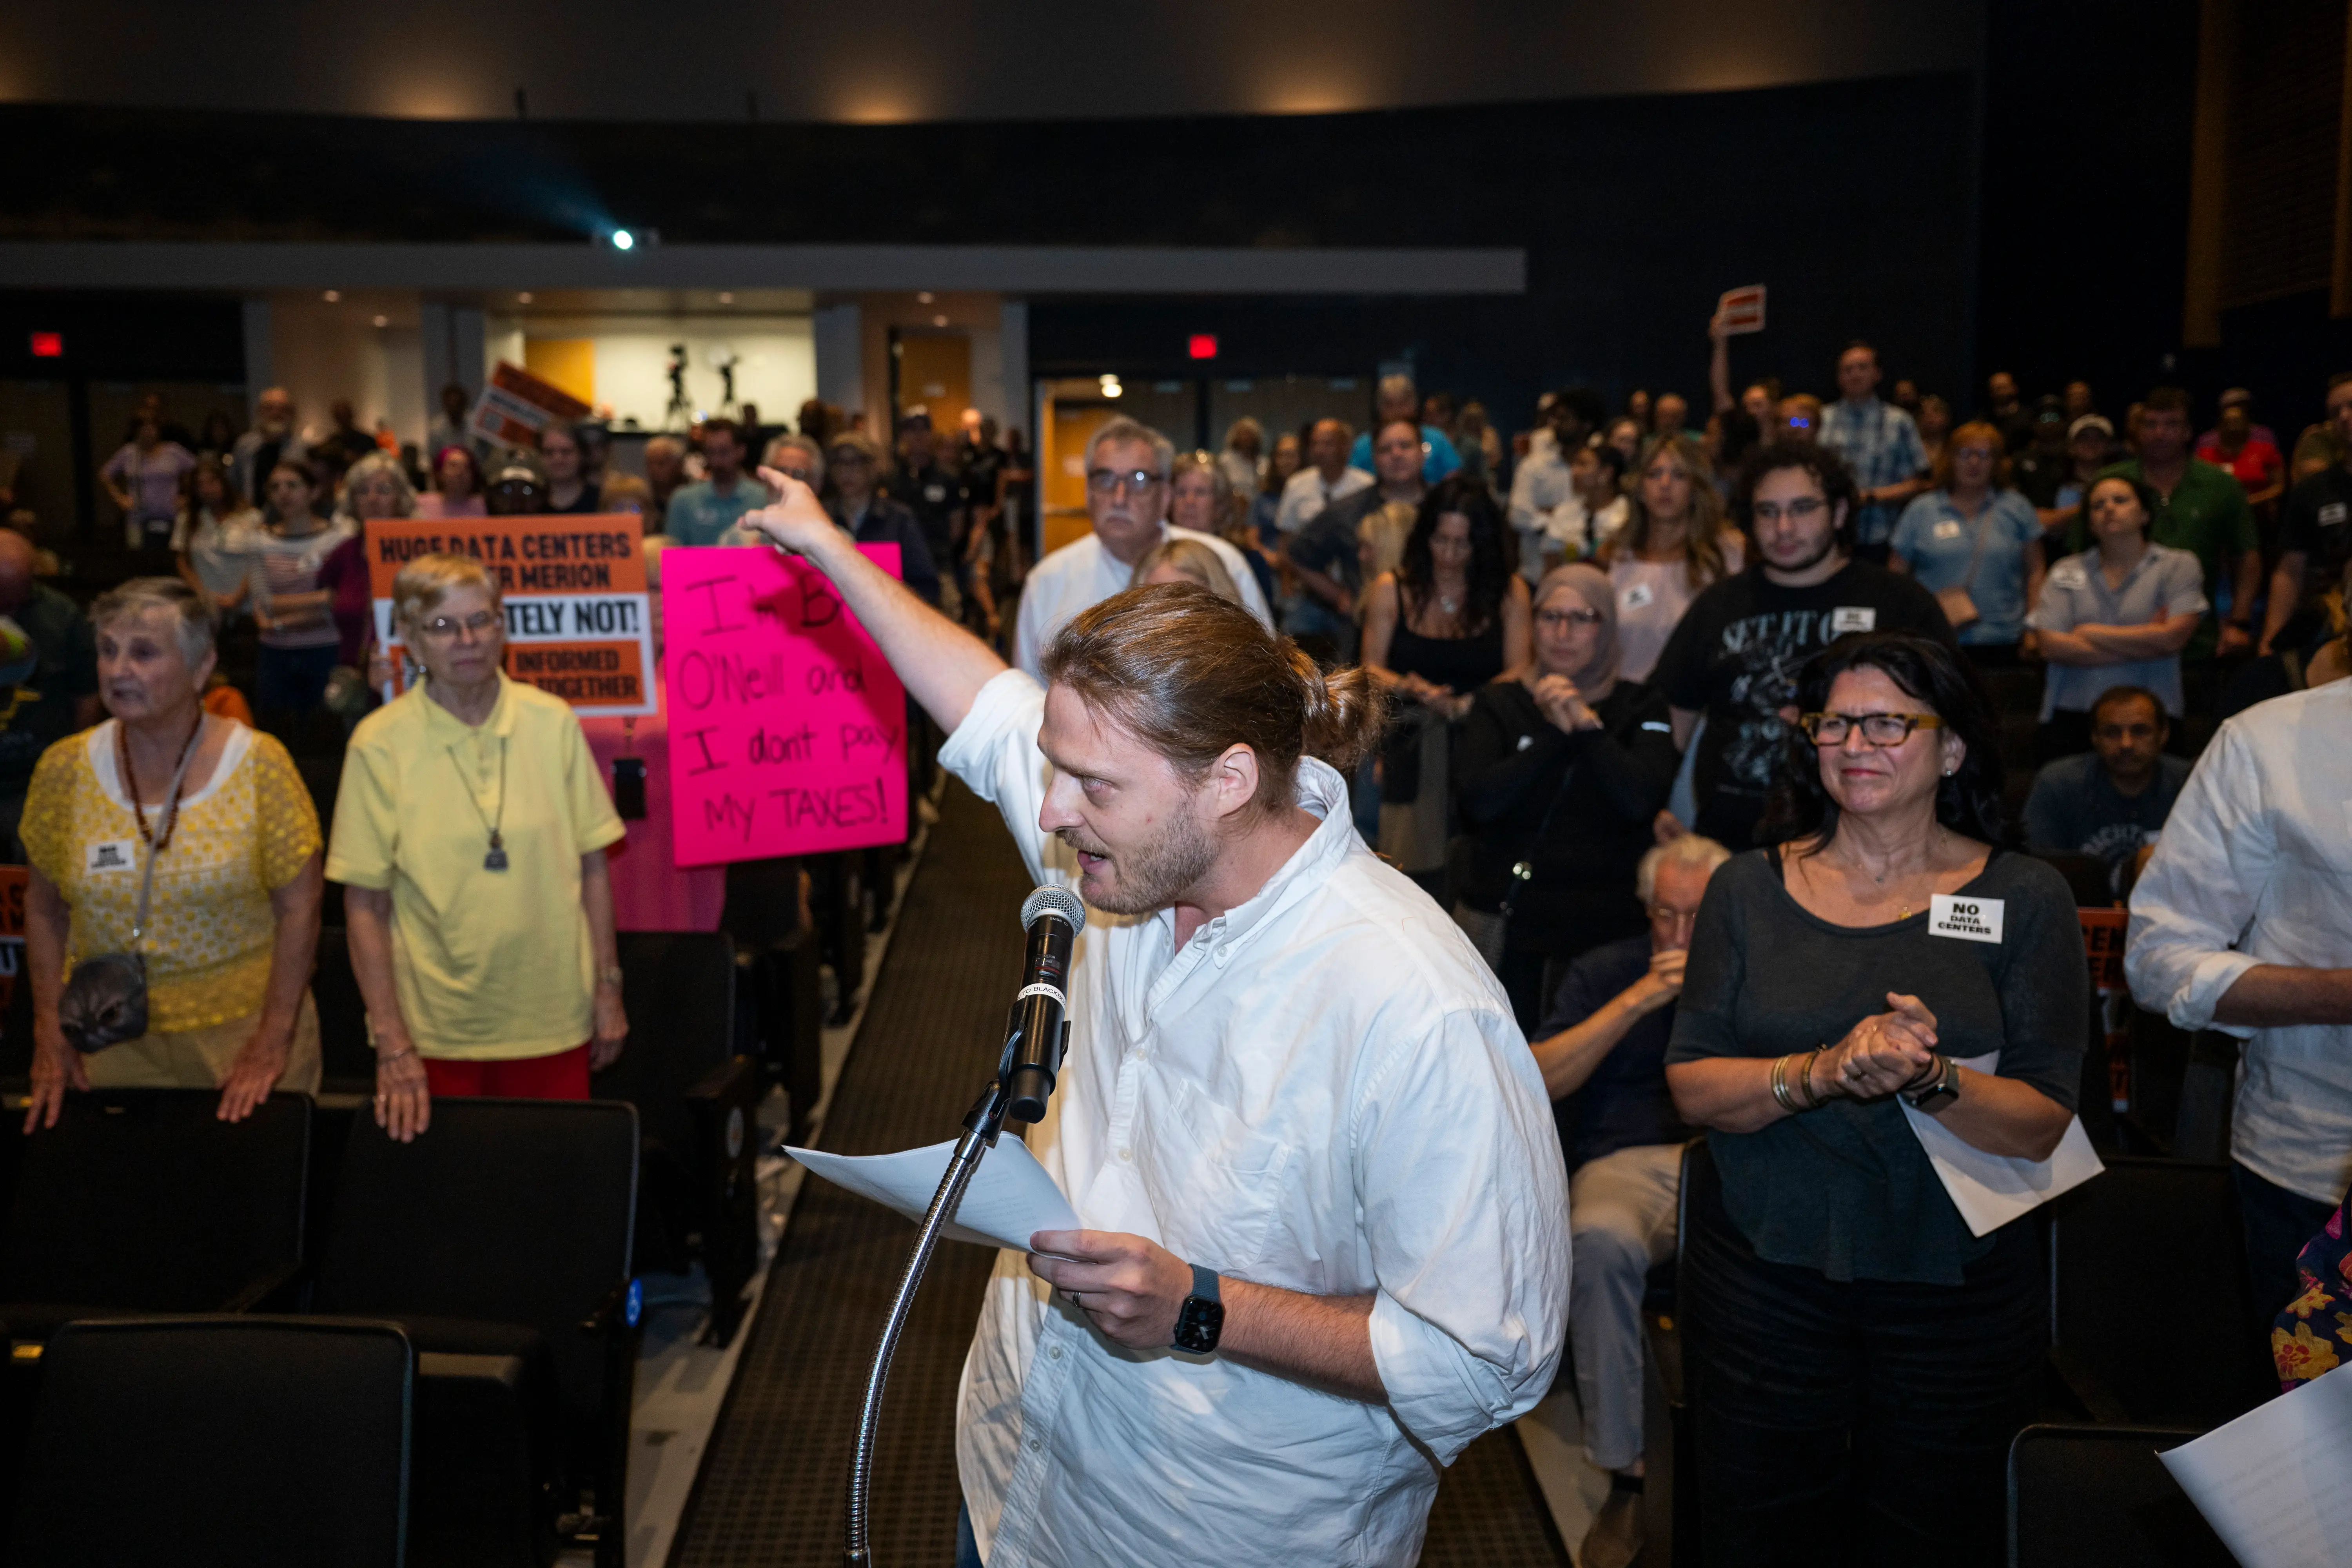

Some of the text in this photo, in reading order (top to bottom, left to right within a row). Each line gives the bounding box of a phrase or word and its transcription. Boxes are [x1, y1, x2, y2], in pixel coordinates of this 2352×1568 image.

[450, 535, 515, 560] DATA
[522, 532, 632, 559] CENTERS
[522, 563, 610, 588] MERION
[574, 600, 640, 633] NOT!
[516, 649, 620, 672] INFORMED
[807, 655, 866, 696] and
[682, 724, 730, 777] I
[839, 722, 900, 764] pay
[767, 775, 889, 828] TAXES!
[1950, 915, 1980, 924] DATA
[1953, 902, 1979, 915] NO
[1938, 921, 1992, 935] CENTERS
